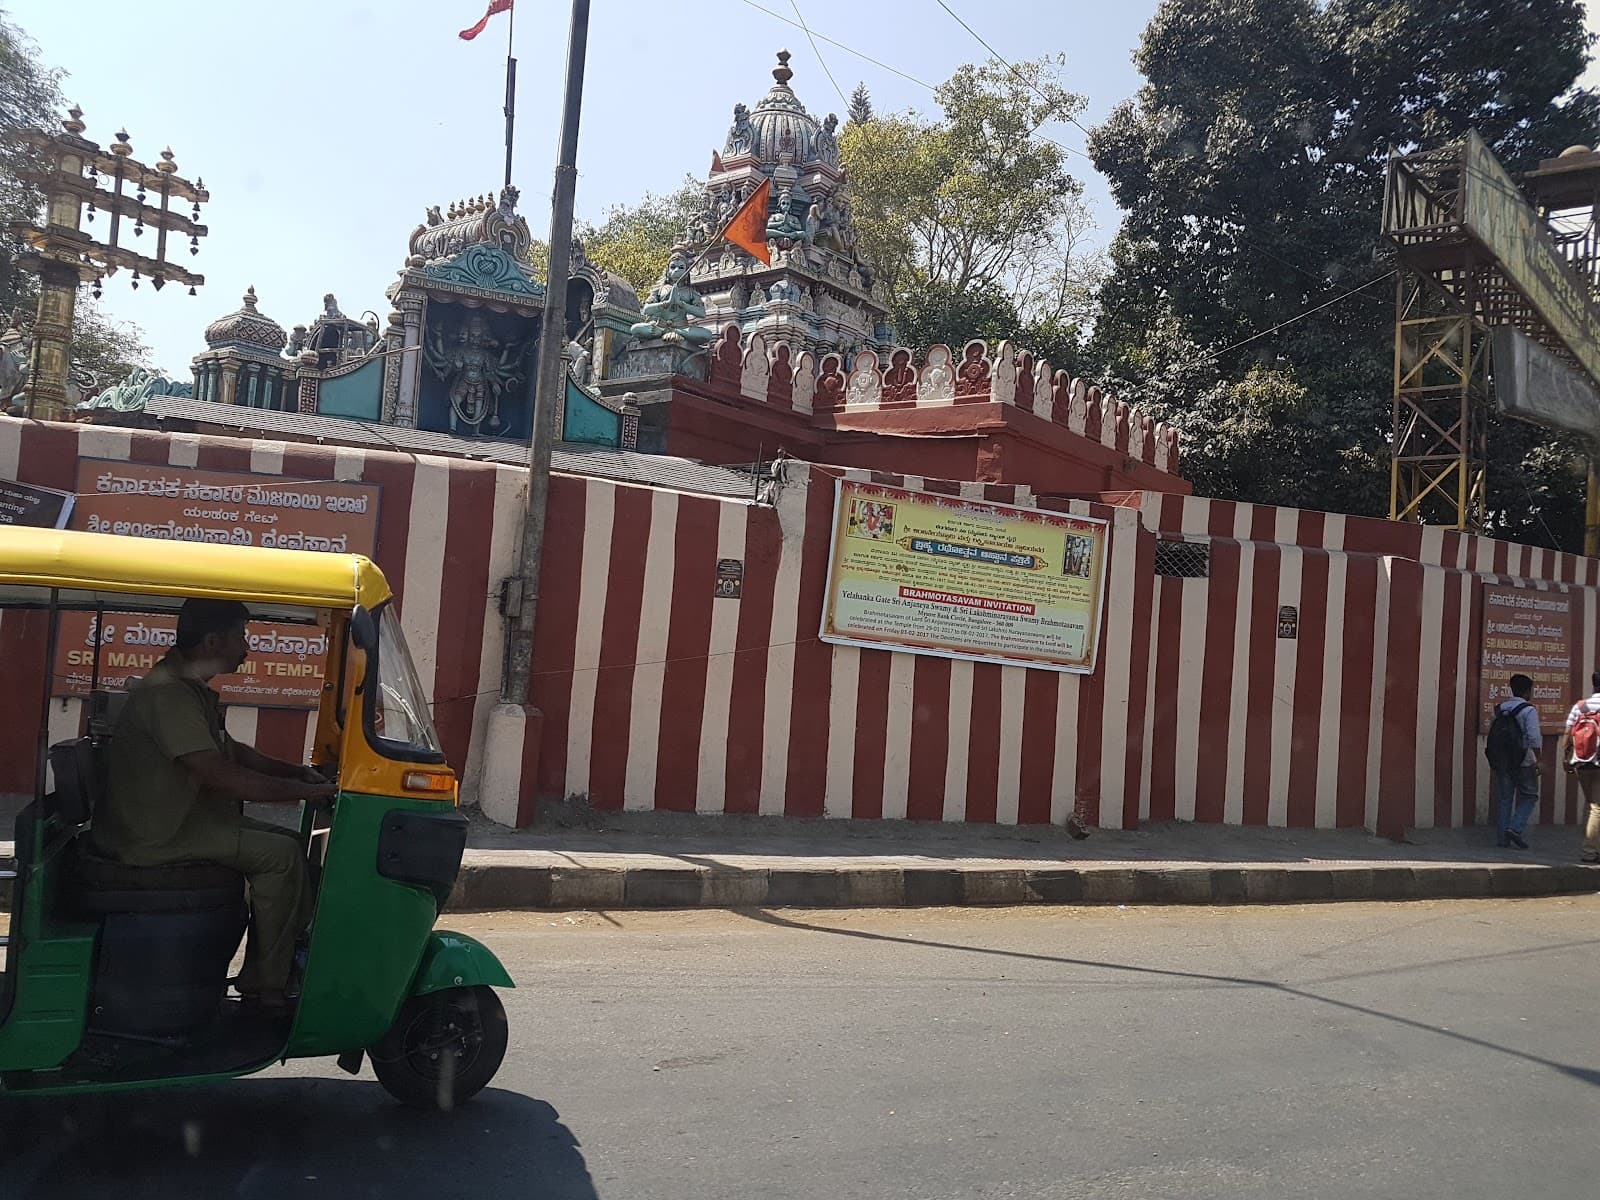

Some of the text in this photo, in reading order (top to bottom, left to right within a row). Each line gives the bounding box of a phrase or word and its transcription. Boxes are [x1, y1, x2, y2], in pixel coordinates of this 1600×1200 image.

[184, 507, 278, 524] ಯಲಹಂಕ ಗೇಟ್
[842, 590, 873, 601] Yelahanka
[875, 594, 890, 603] Gate
[892, 596, 900, 605] Sri
[902, 598, 929, 610] Anjaneya
[930, 602, 950, 613] Swamy
[1020, 614, 1038, 625] Swamy
[902, 588, 981, 606] BRAHMOTASAVAM
[984, 599, 1031, 613] INVITATION
[67, 650, 95, 666] SR
[264, 662, 325, 679] TEMPL
